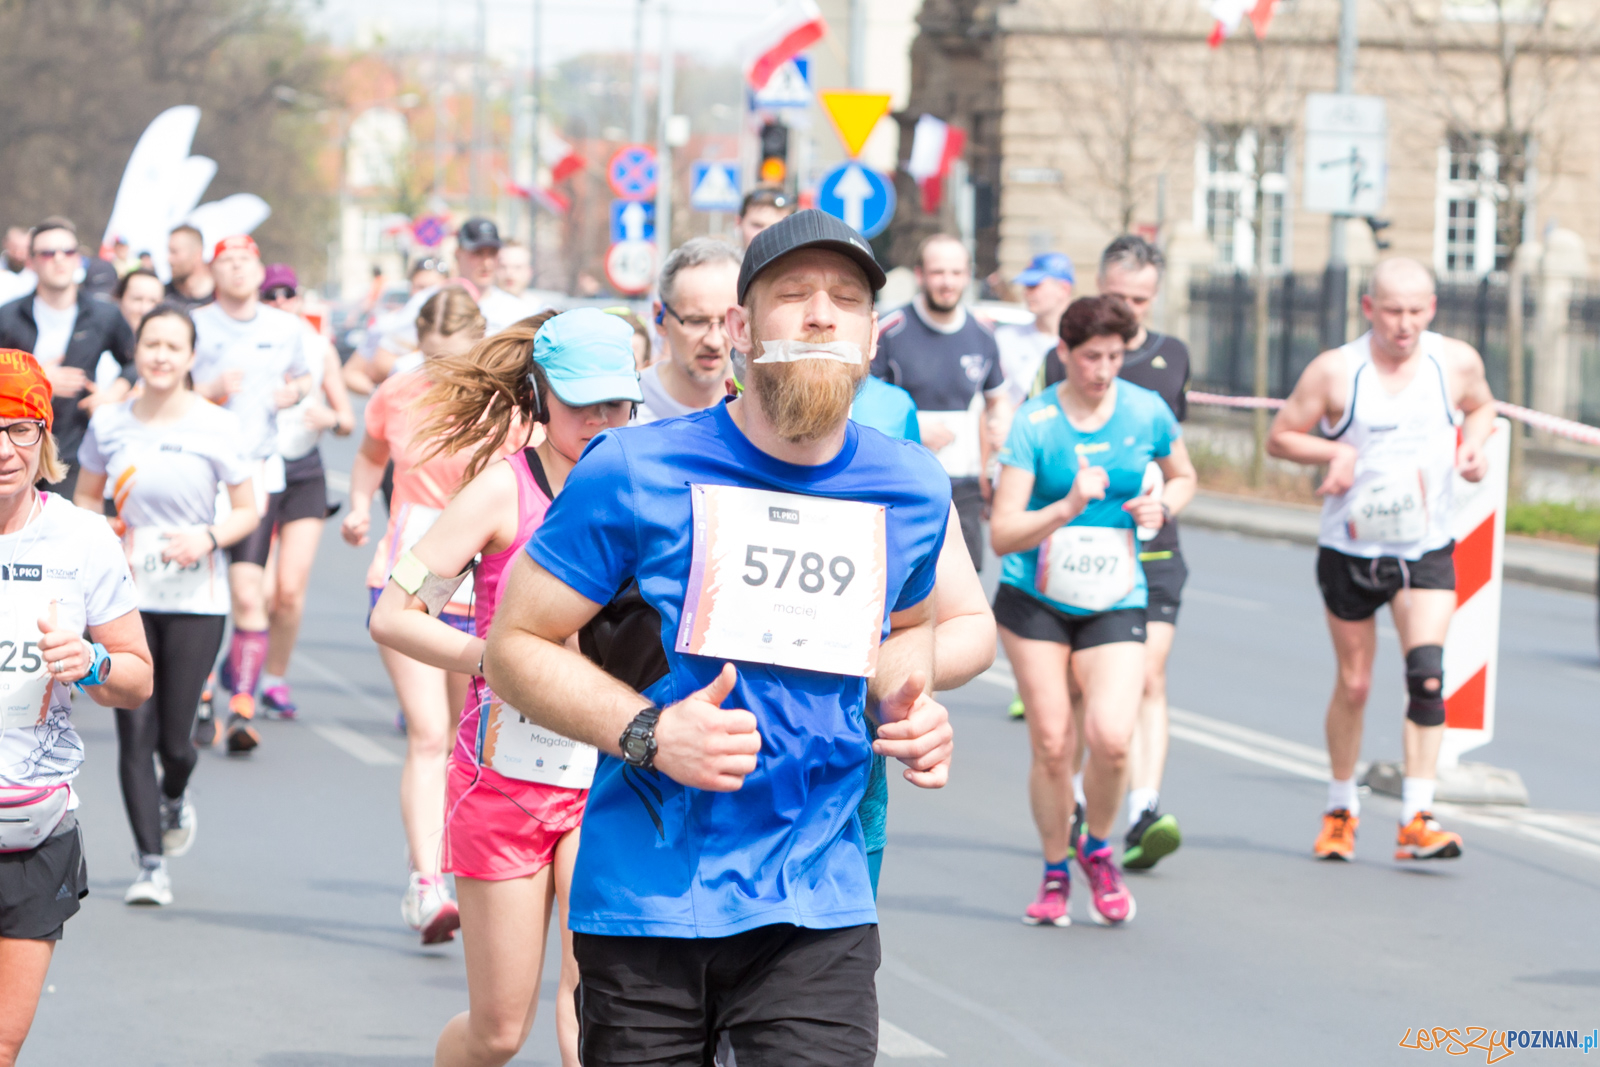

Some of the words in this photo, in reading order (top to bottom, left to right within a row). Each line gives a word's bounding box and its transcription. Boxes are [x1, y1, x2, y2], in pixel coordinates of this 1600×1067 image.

[741, 544, 856, 597] 5789
[1062, 554, 1119, 575] 4897
[773, 602, 817, 620] maciej
